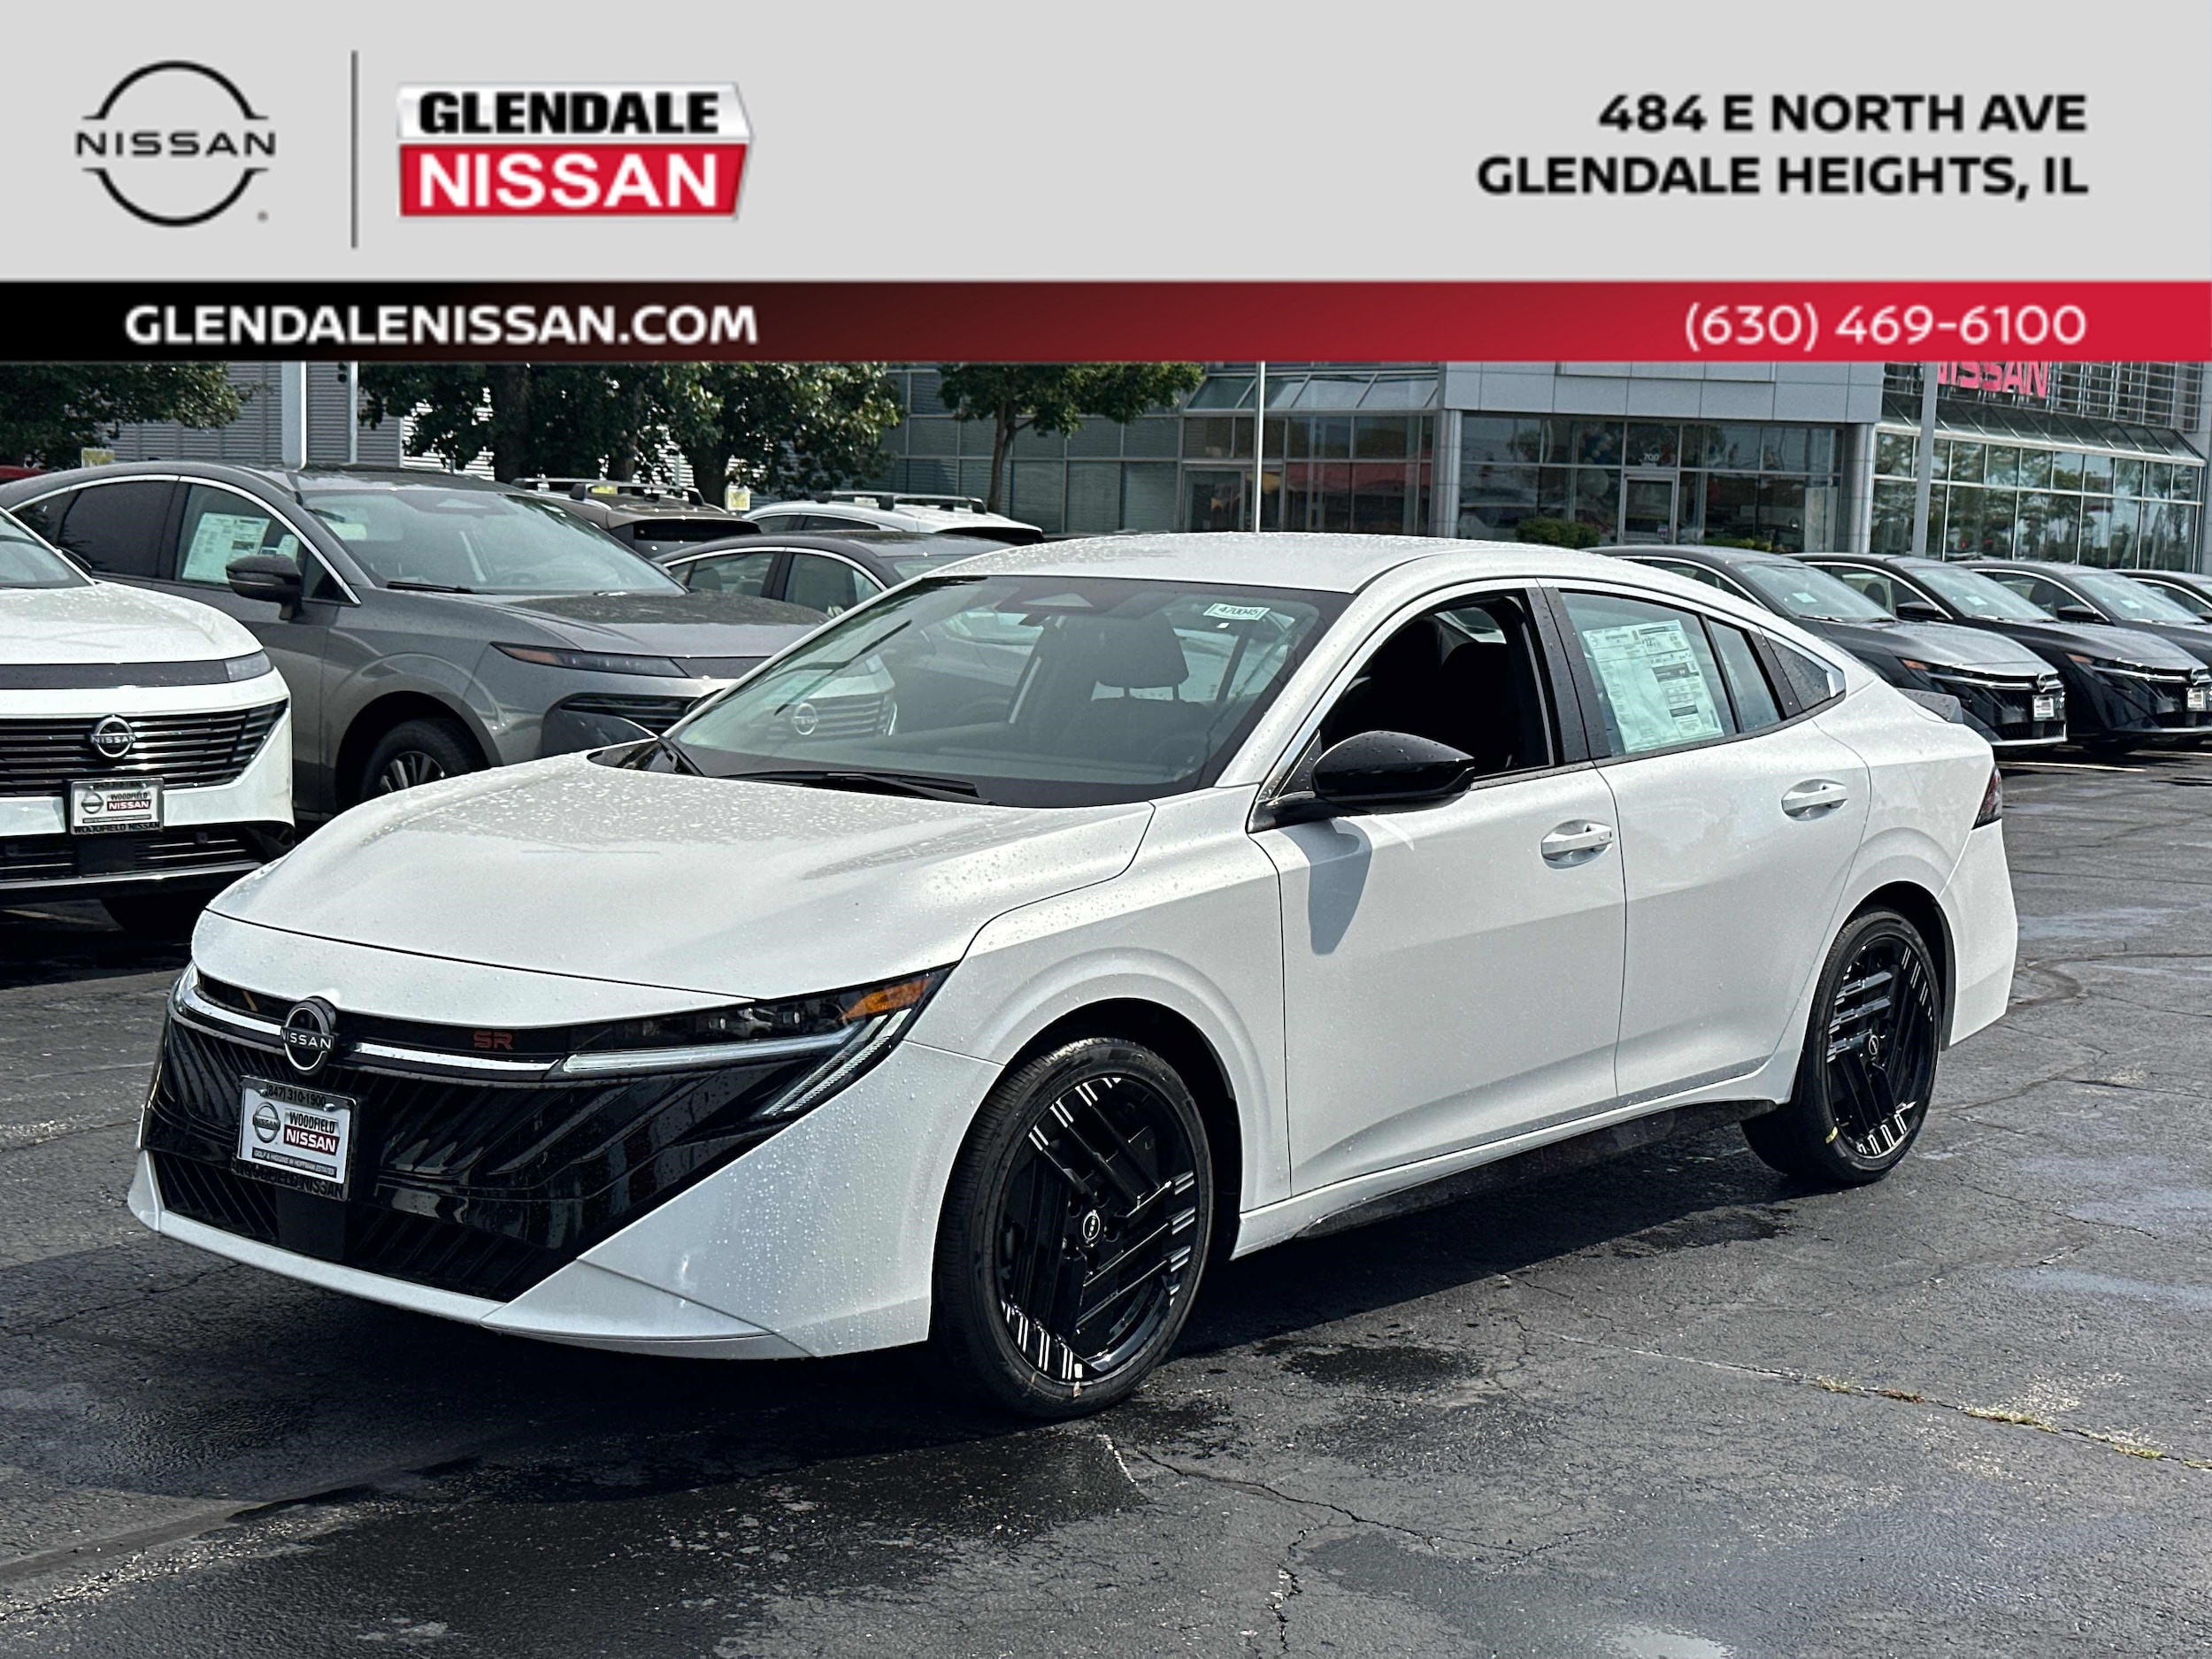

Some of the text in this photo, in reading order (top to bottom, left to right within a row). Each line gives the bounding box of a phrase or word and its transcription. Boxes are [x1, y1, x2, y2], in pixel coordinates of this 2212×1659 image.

[1644, 453, 1660, 462] 700
[91, 734, 136, 744] NISSAN
[109, 800, 150, 810] NISSAN
[280, 1029, 332, 1048] NISSAN
[473, 1031, 513, 1050] SR
[289, 1111, 335, 1133] WOODFIELD
[286, 1128, 336, 1153] NISSAN
